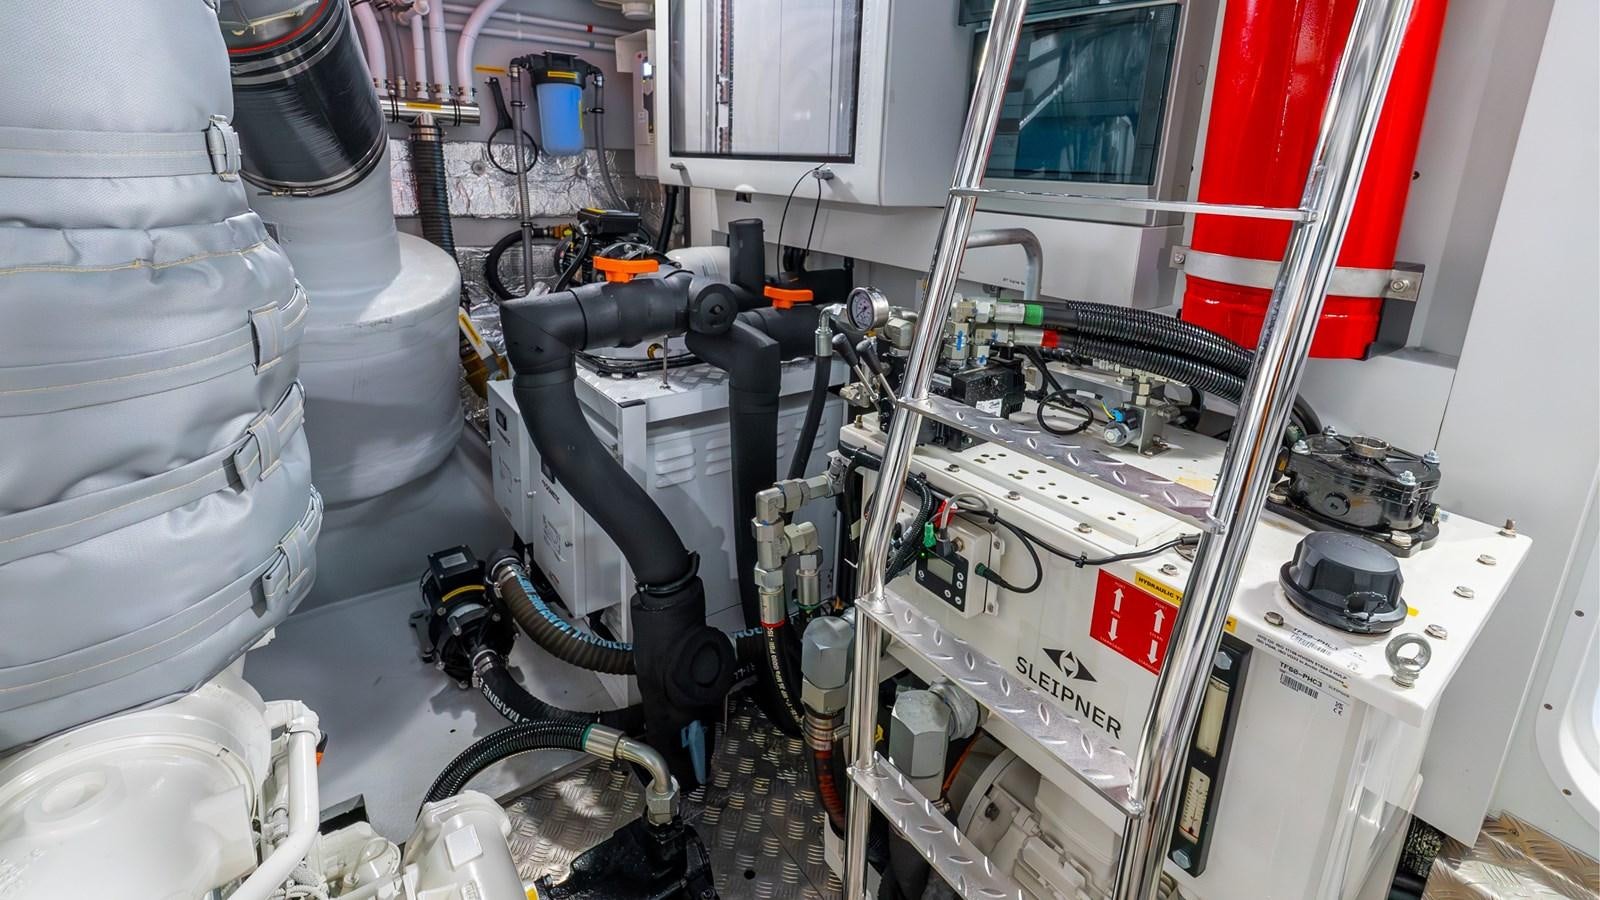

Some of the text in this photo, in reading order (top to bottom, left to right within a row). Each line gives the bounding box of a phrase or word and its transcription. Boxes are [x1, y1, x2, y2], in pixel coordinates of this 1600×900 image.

[1138, 576, 1174, 598] HYDRAULIC
[1279, 661, 1323, 688] TF60-PHC3
[482, 684, 521, 724] MARINE
[1016, 656, 1122, 740] SLEIPNER
